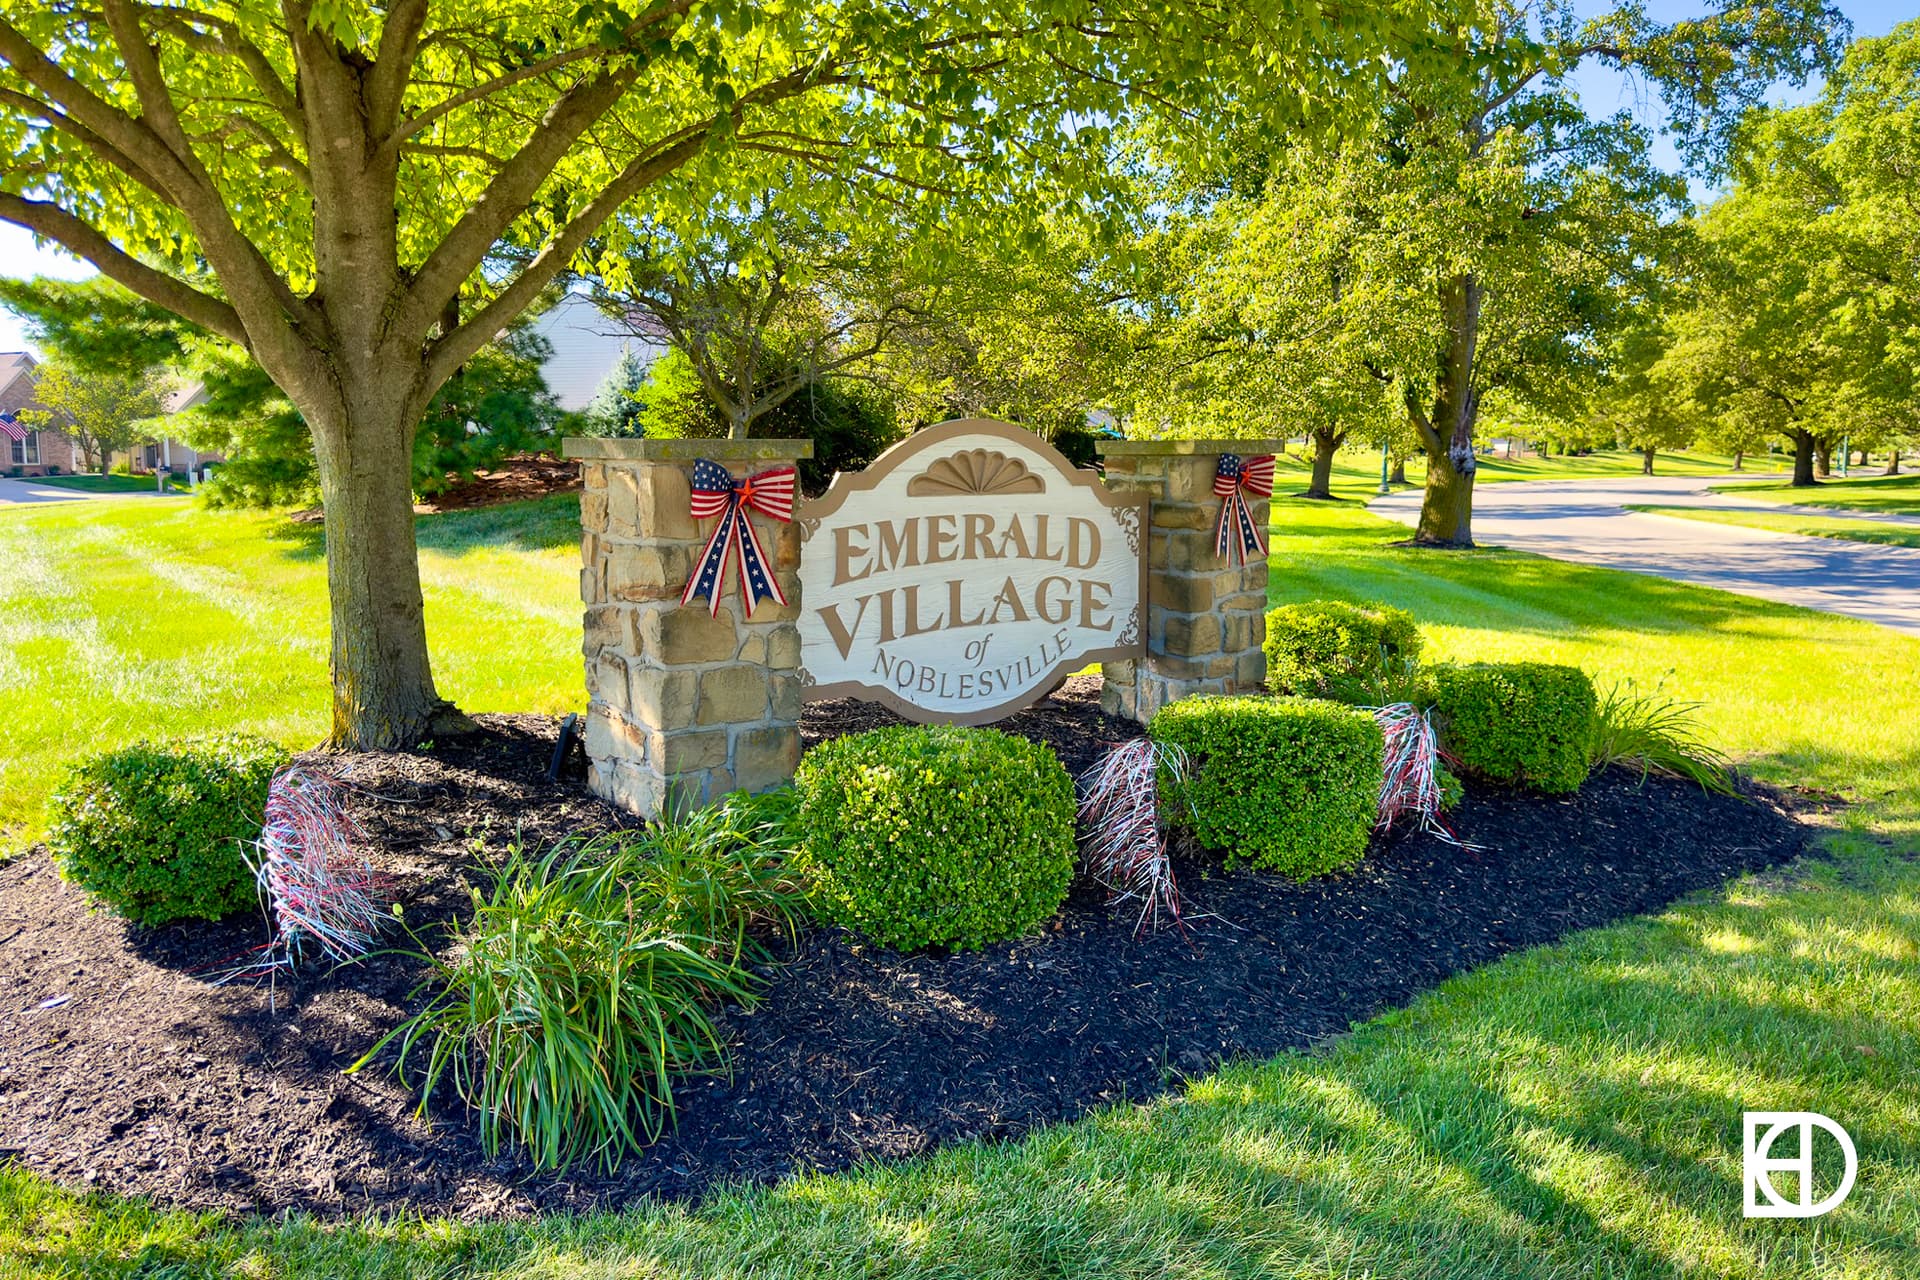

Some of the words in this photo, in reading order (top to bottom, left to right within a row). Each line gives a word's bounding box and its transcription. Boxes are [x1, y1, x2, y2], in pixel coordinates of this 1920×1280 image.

[832, 513, 1102, 587] EMERALD
[815, 576, 1115, 661] VILLAGE
[964, 633, 994, 667] of
[871, 628, 1073, 699] NOBLESVILLE
